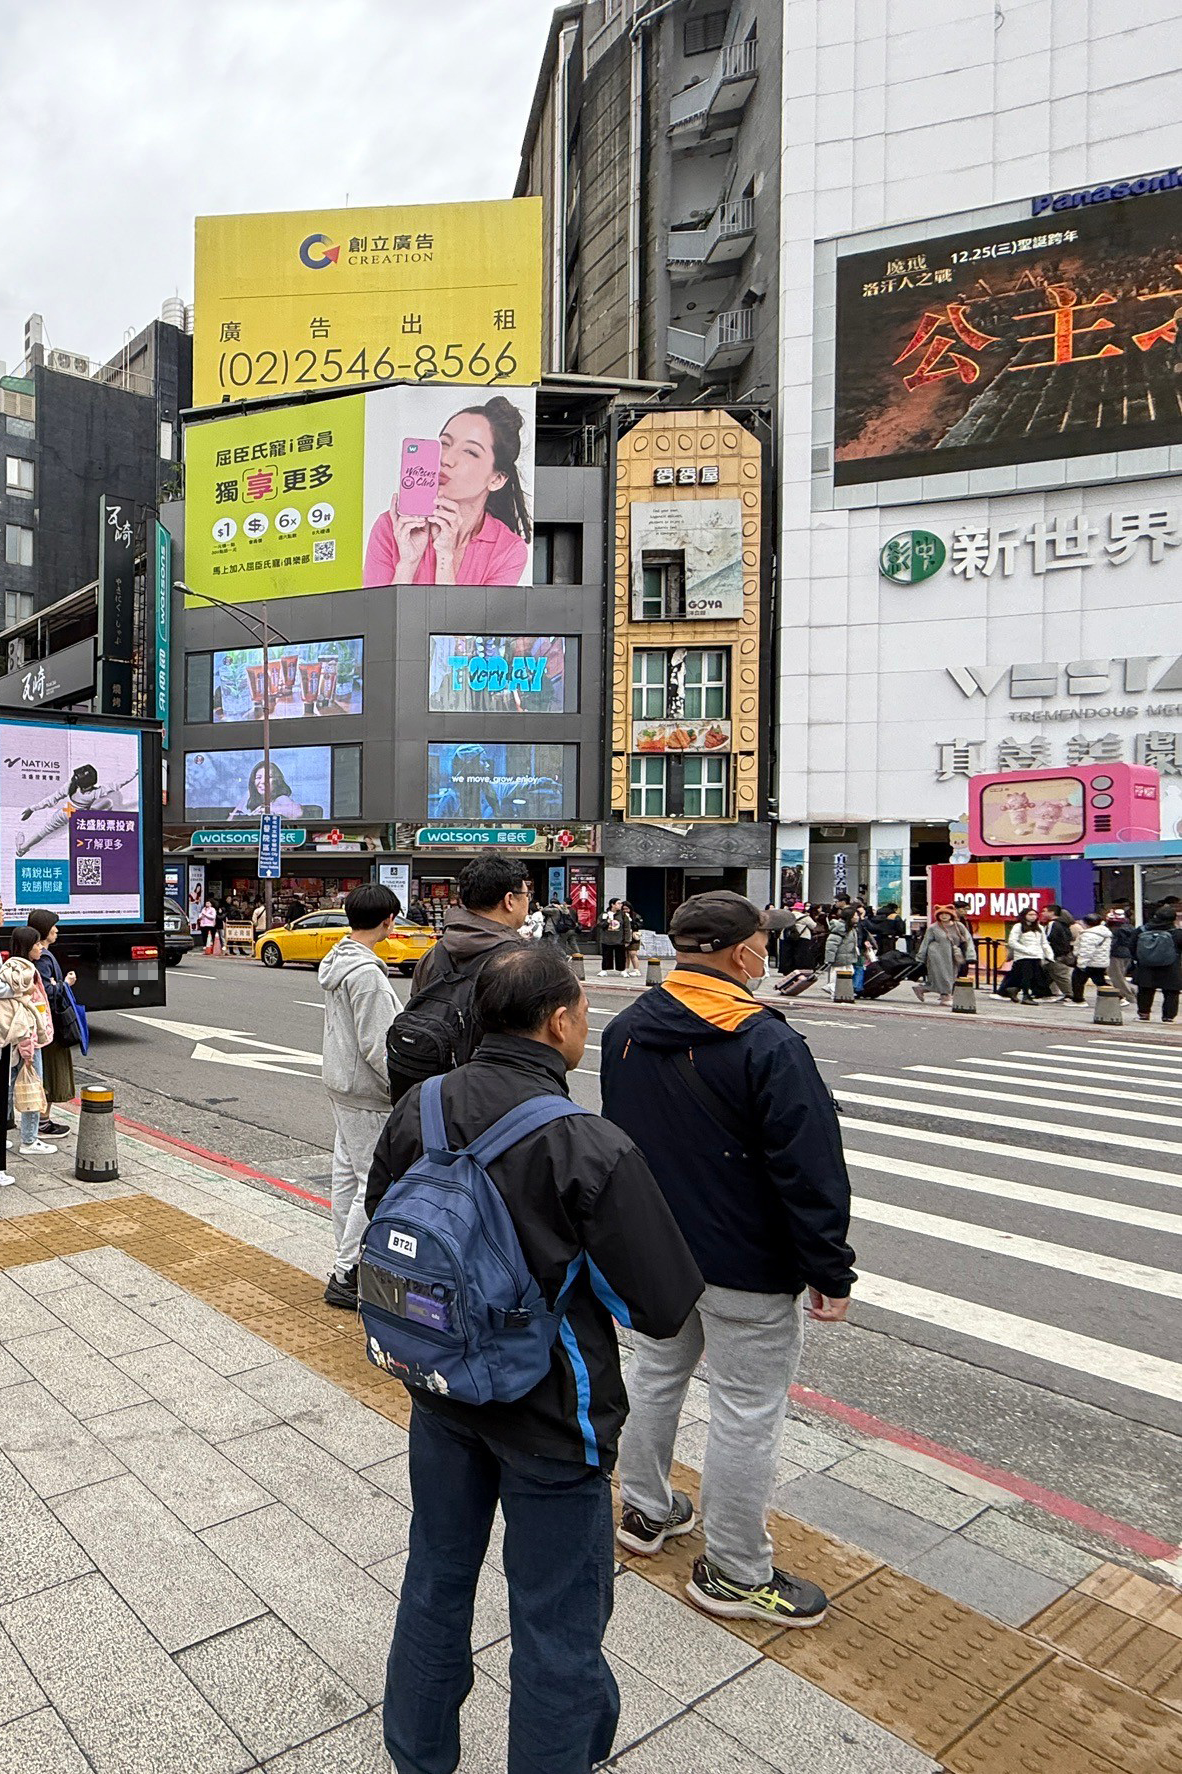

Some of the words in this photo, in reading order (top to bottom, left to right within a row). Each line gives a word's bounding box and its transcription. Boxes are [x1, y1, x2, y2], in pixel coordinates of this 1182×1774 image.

[348, 233, 434, 254] 創立廣告
[950, 228, 1079, 264] 12.25(三)聖誕跨年
[348, 252, 434, 266] CREATION
[883, 254, 928, 277] 魔戒
[219, 308, 517, 344] 廣告出租
[218, 341, 518, 387] (02)2546-8566
[215, 430, 334, 468] 屈臣氏寵i會員
[215, 463, 334, 505] 獨享更多
[217, 522, 230, 537] $1
[952, 508, 1182, 579] 新世界
[159, 545, 167, 625] watsons
[688, 599, 723, 609] GOYA
[448, 656, 548, 692] TODAY
[1008, 704, 1139, 723] TREMENDOUS
[21, 759, 60, 769] NATIXIS
[76, 818, 135, 833] 法盛股票投資
[84, 838, 123, 850] 了解更多
[199, 832, 259, 843] watsons
[427, 832, 490, 842] watsons
[497, 832, 527, 843] 屈臣氏
[21, 866, 63, 879] 精銳出手
[21, 880, 63, 893] 致勝關鍵
[954, 892, 986, 916] POP
[990, 892, 1041, 917] MART
[392, 1236, 413, 1252] BT21
